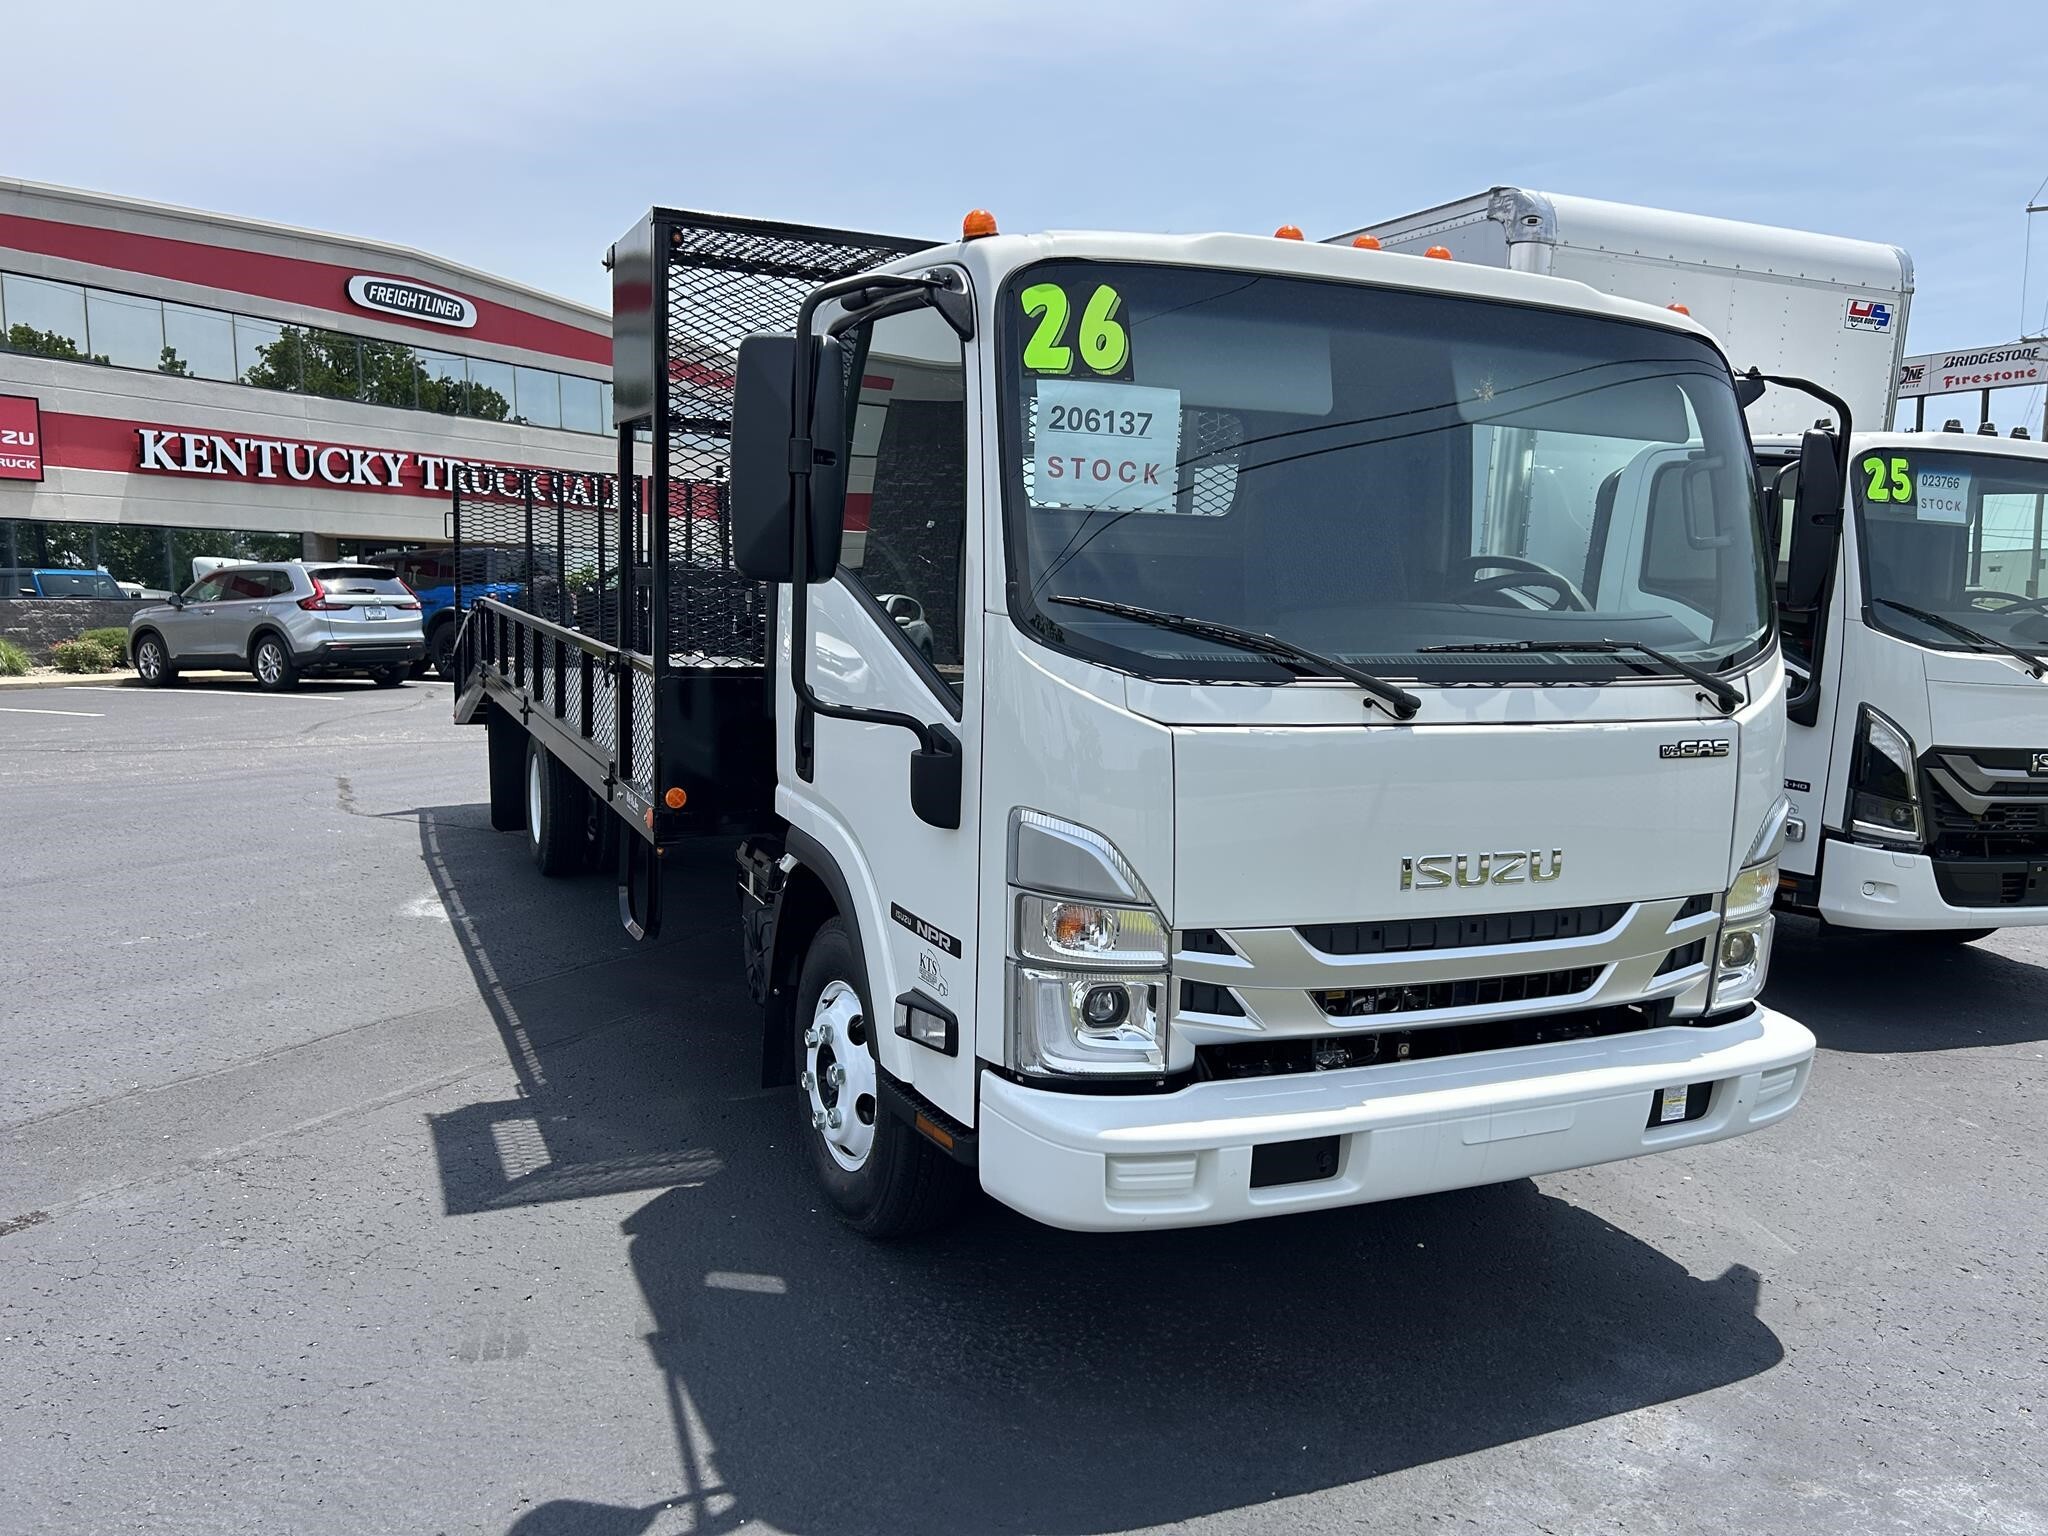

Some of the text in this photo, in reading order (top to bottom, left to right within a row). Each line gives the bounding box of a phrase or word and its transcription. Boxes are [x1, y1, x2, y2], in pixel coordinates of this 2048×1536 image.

[369, 285, 460, 318] FREIGHTLINER
[1849, 301, 1891, 326] US
[1021, 282, 1130, 375] 26
[1943, 346, 2040, 369] BRIDGESTONE
[1943, 368, 2038, 389] Firestone
[1048, 405, 1153, 436] 206137
[138, 429, 408, 487] KENTUCKY
[1047, 456, 1160, 485] STOCK
[1862, 457, 1912, 503] 25
[1921, 474, 1960, 489] 023766
[1921, 498, 1962, 511] STOCK
[1400, 848, 1562, 891] ISUZU
[895, 909, 951, 952] ISUZU NPR
[919, 952, 938, 976] KTS
